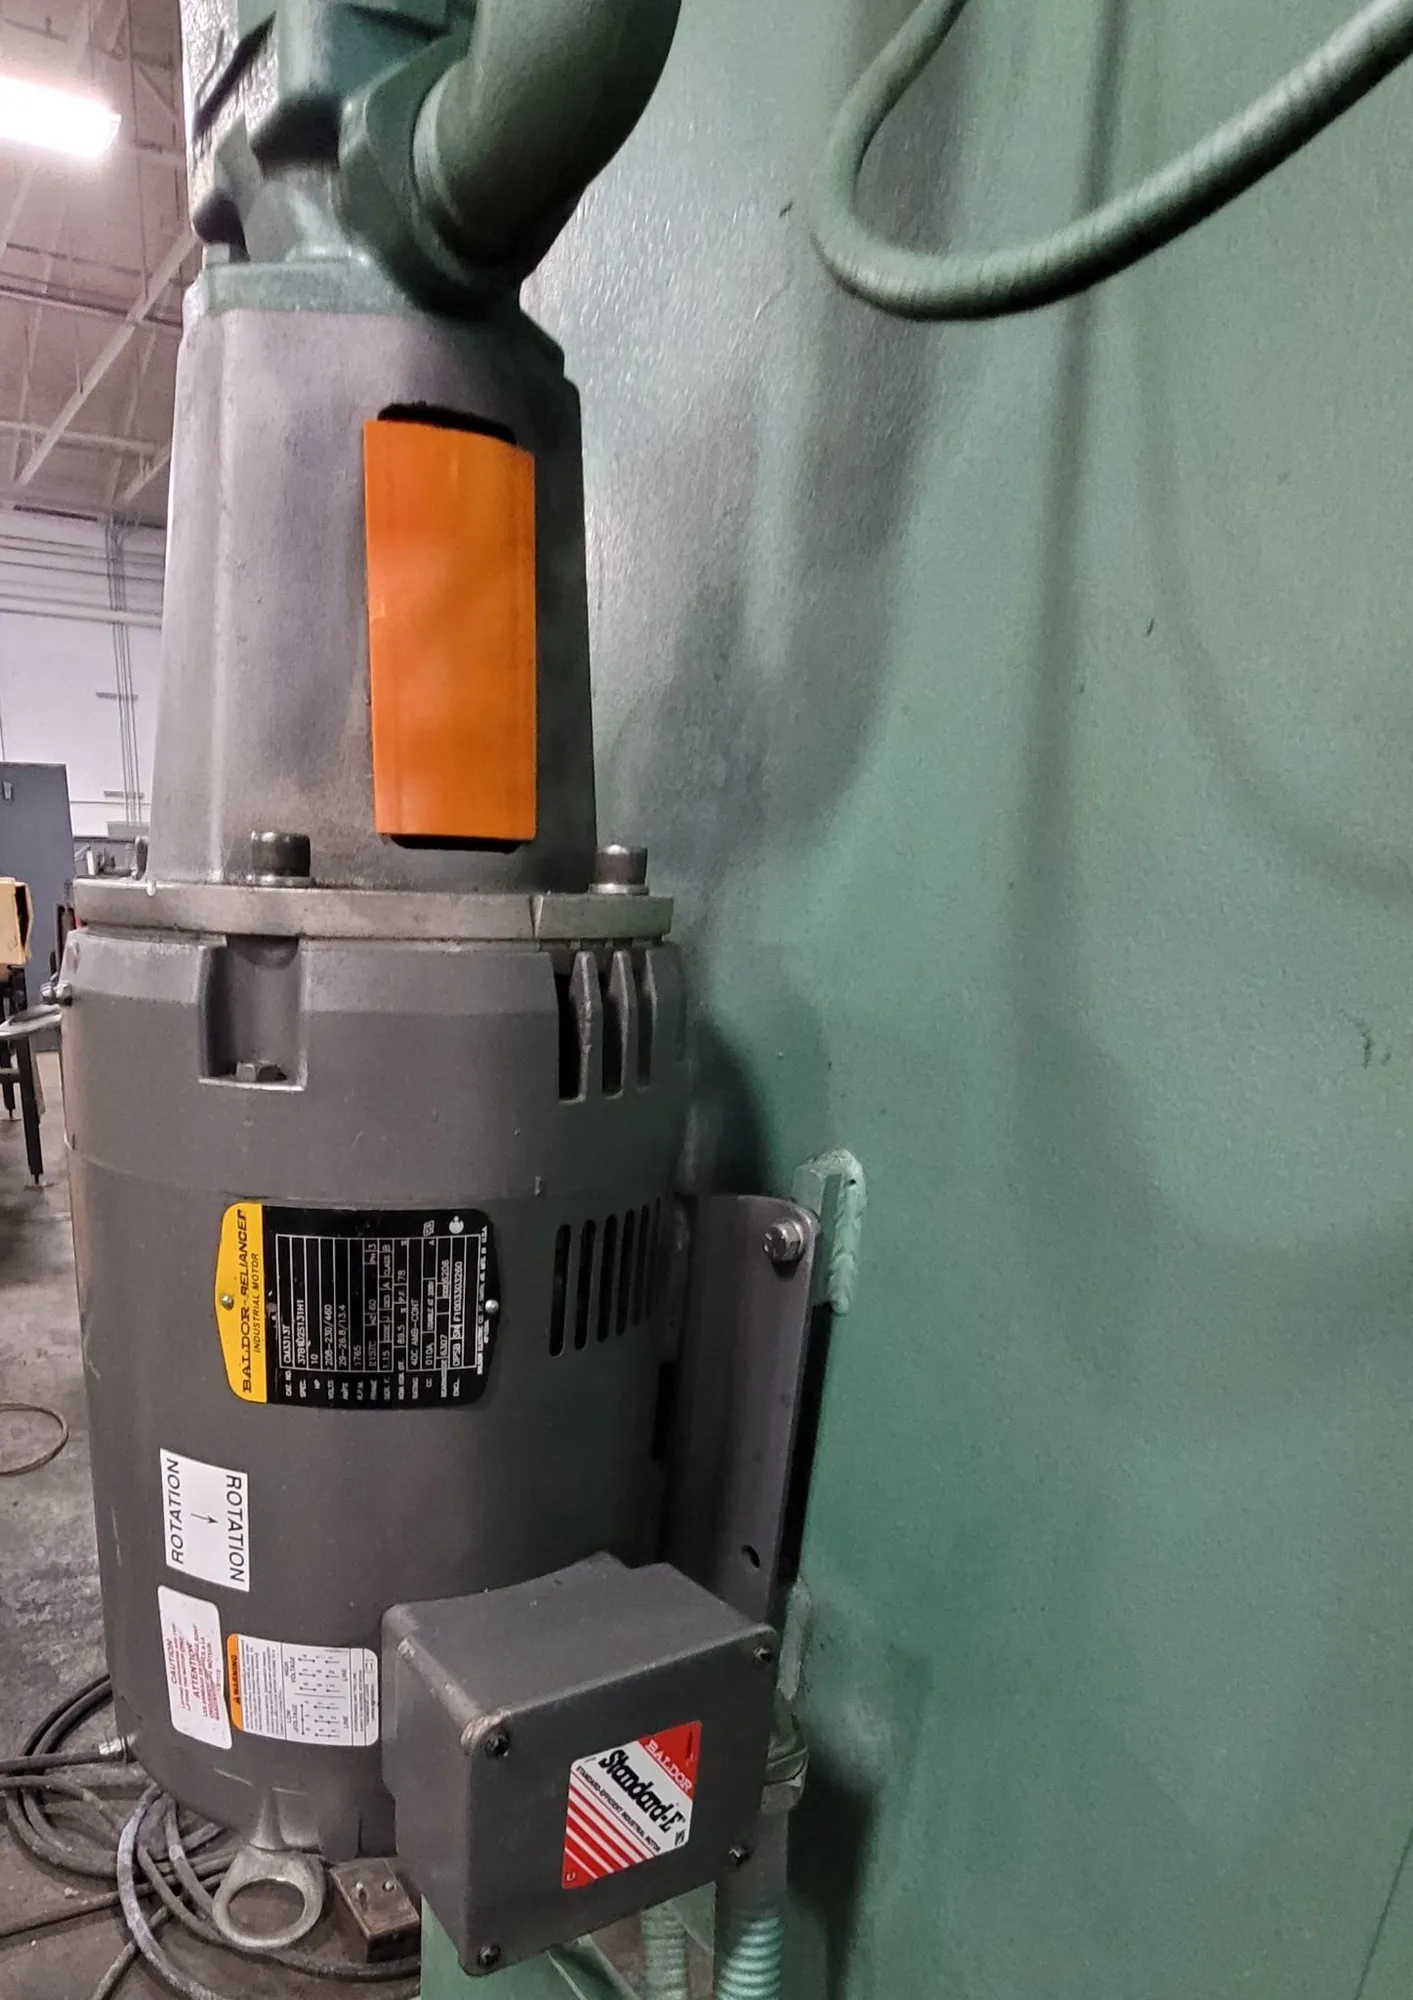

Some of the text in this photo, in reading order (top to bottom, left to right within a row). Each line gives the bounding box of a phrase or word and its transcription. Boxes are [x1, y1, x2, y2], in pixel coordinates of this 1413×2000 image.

[398, 1270, 405, 1282] 78
[251, 1253, 261, 1353] INDUSTRIAL MOTOR
[282, 1324, 290, 1363] CM3313T
[311, 1354, 318, 1364] 10
[324, 1305, 333, 1366] 208-230/460
[166, 1458, 184, 1564] ROTATION
[226, 1475, 245, 1582] ROTATION
[167, 1639, 177, 1684] CAUTION
[186, 1640, 200, 1698] ATTENTION
[231, 1655, 239, 1695] WARNING
[645, 1739, 692, 1792] BALDOR
